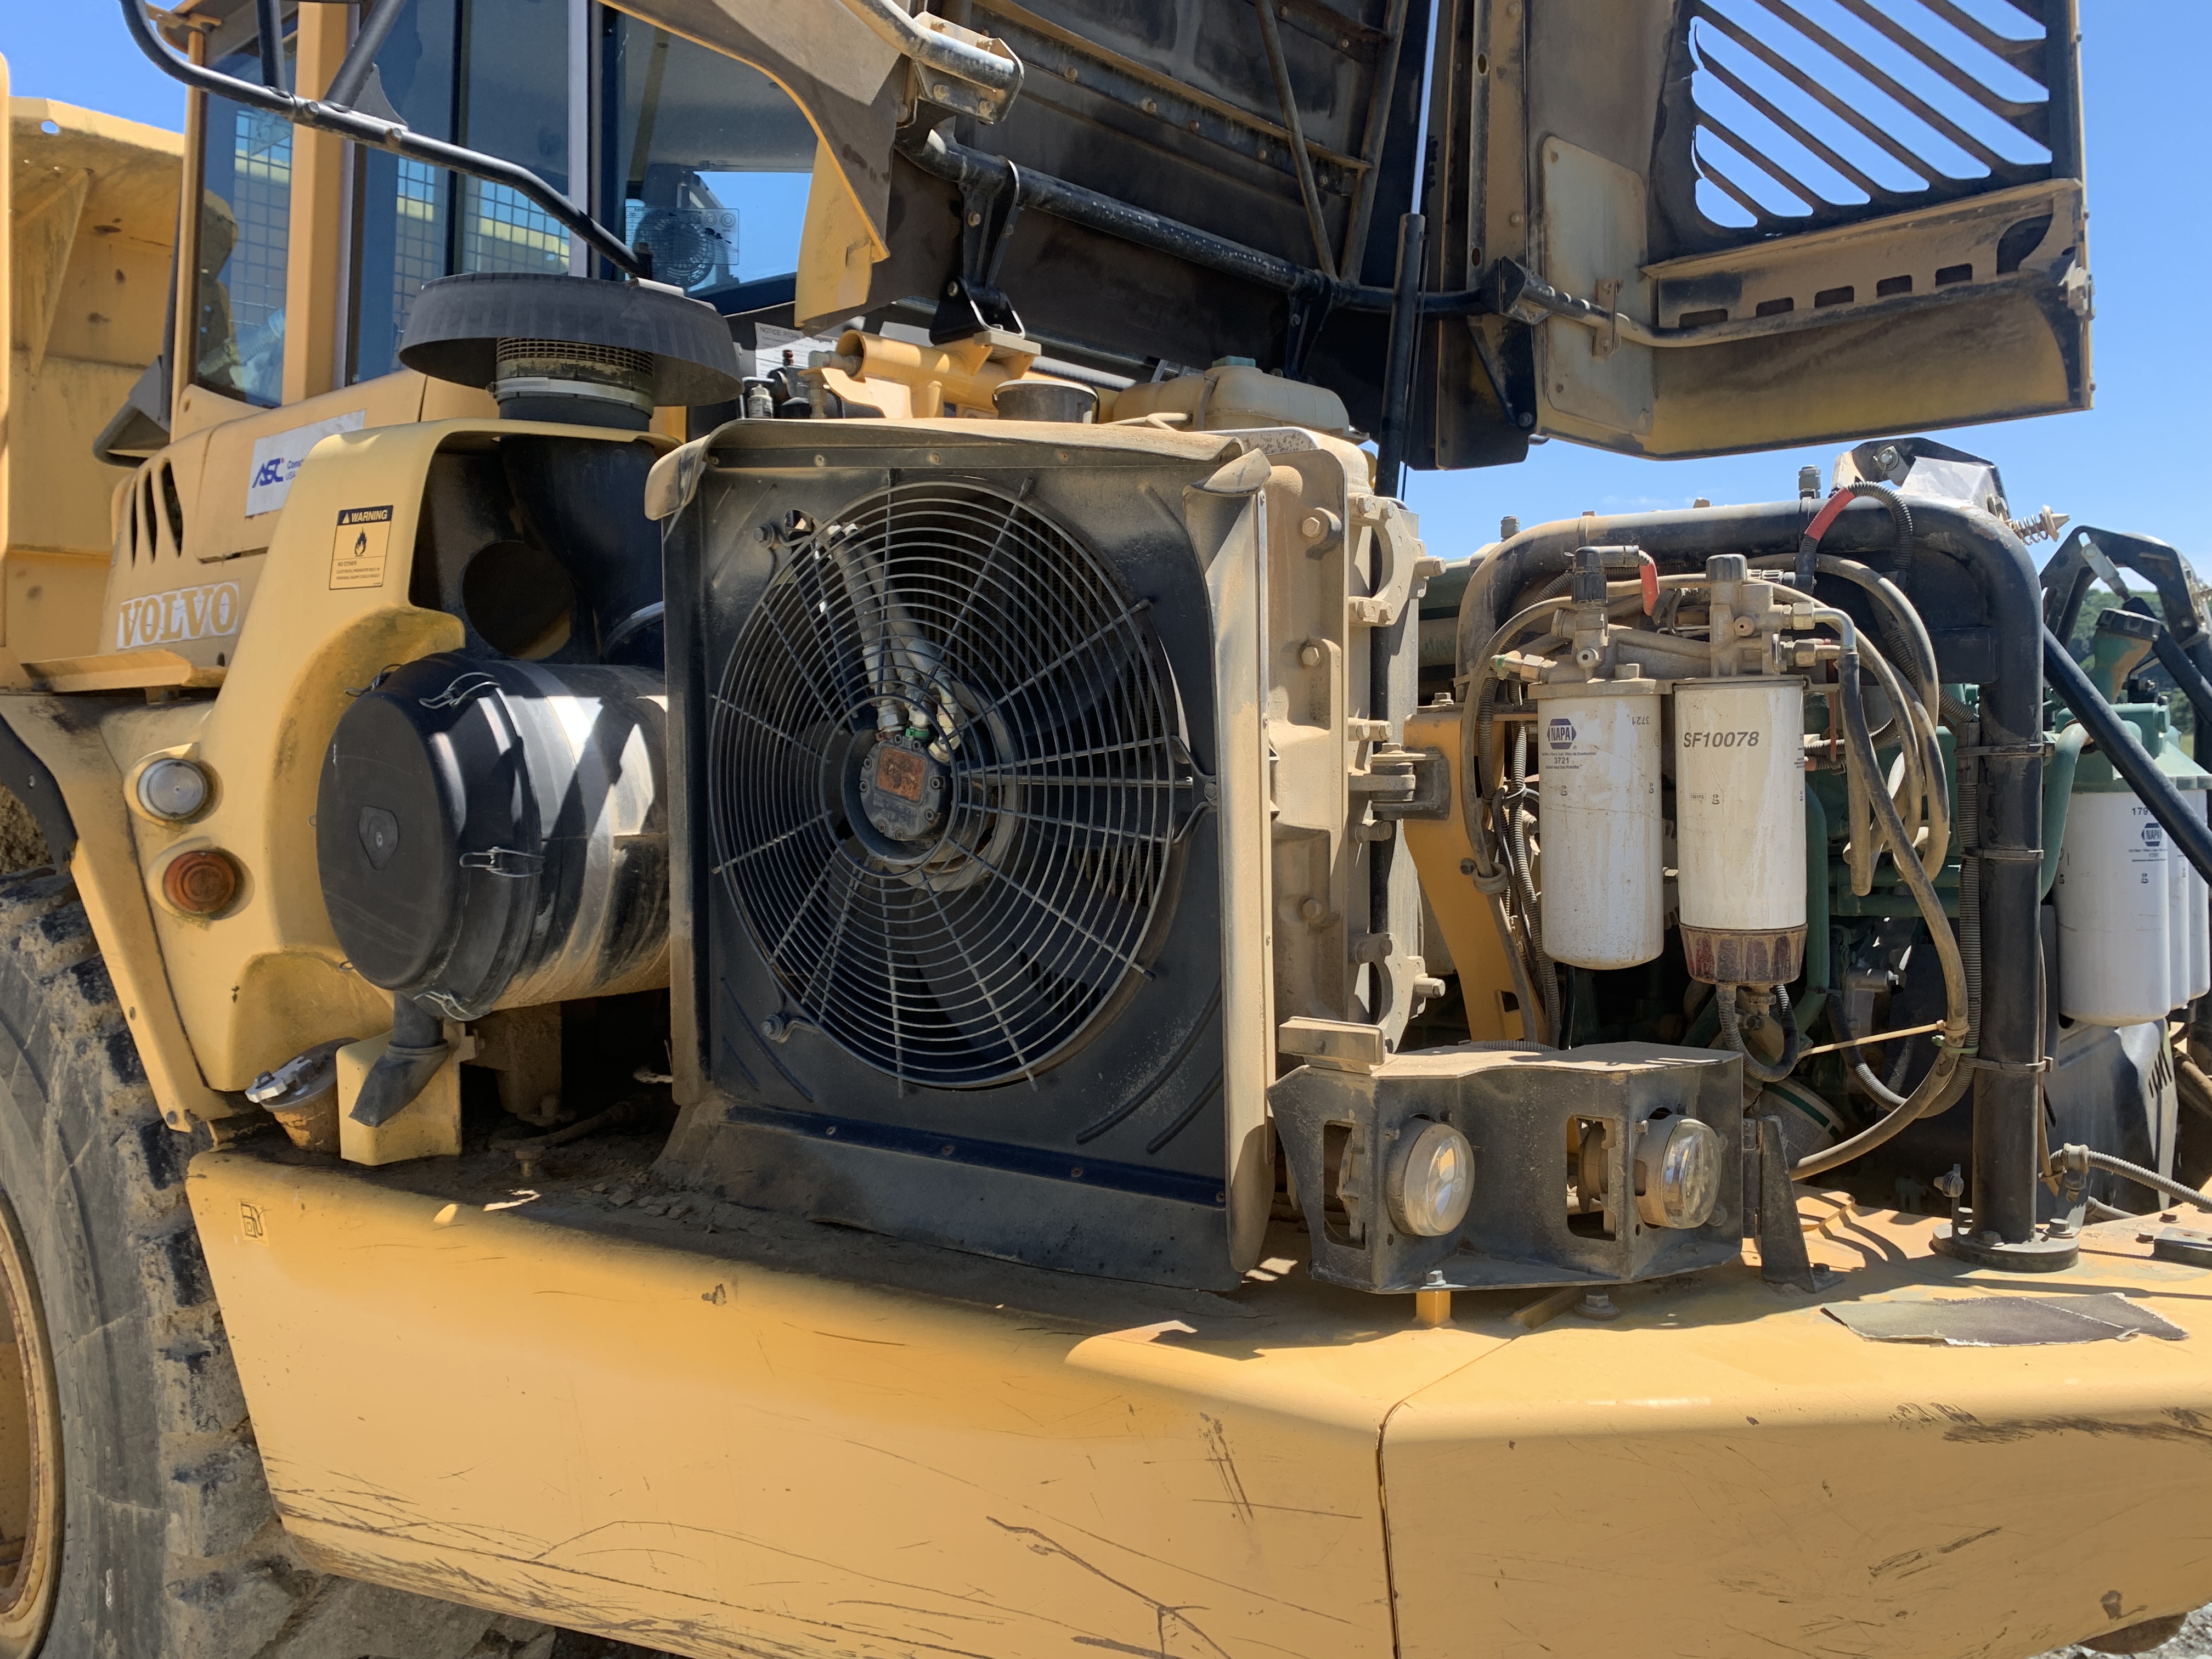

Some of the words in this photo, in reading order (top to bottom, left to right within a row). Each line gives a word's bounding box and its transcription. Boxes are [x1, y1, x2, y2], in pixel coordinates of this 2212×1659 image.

[760, 326, 782, 336] NOTICE:
[352, 509, 387, 523] WARNING
[120, 584, 238, 647] VOLVO
[1632, 716, 1650, 725] 3721
[1551, 727, 1571, 741] NAPA
[1684, 731, 1759, 748] SF10078
